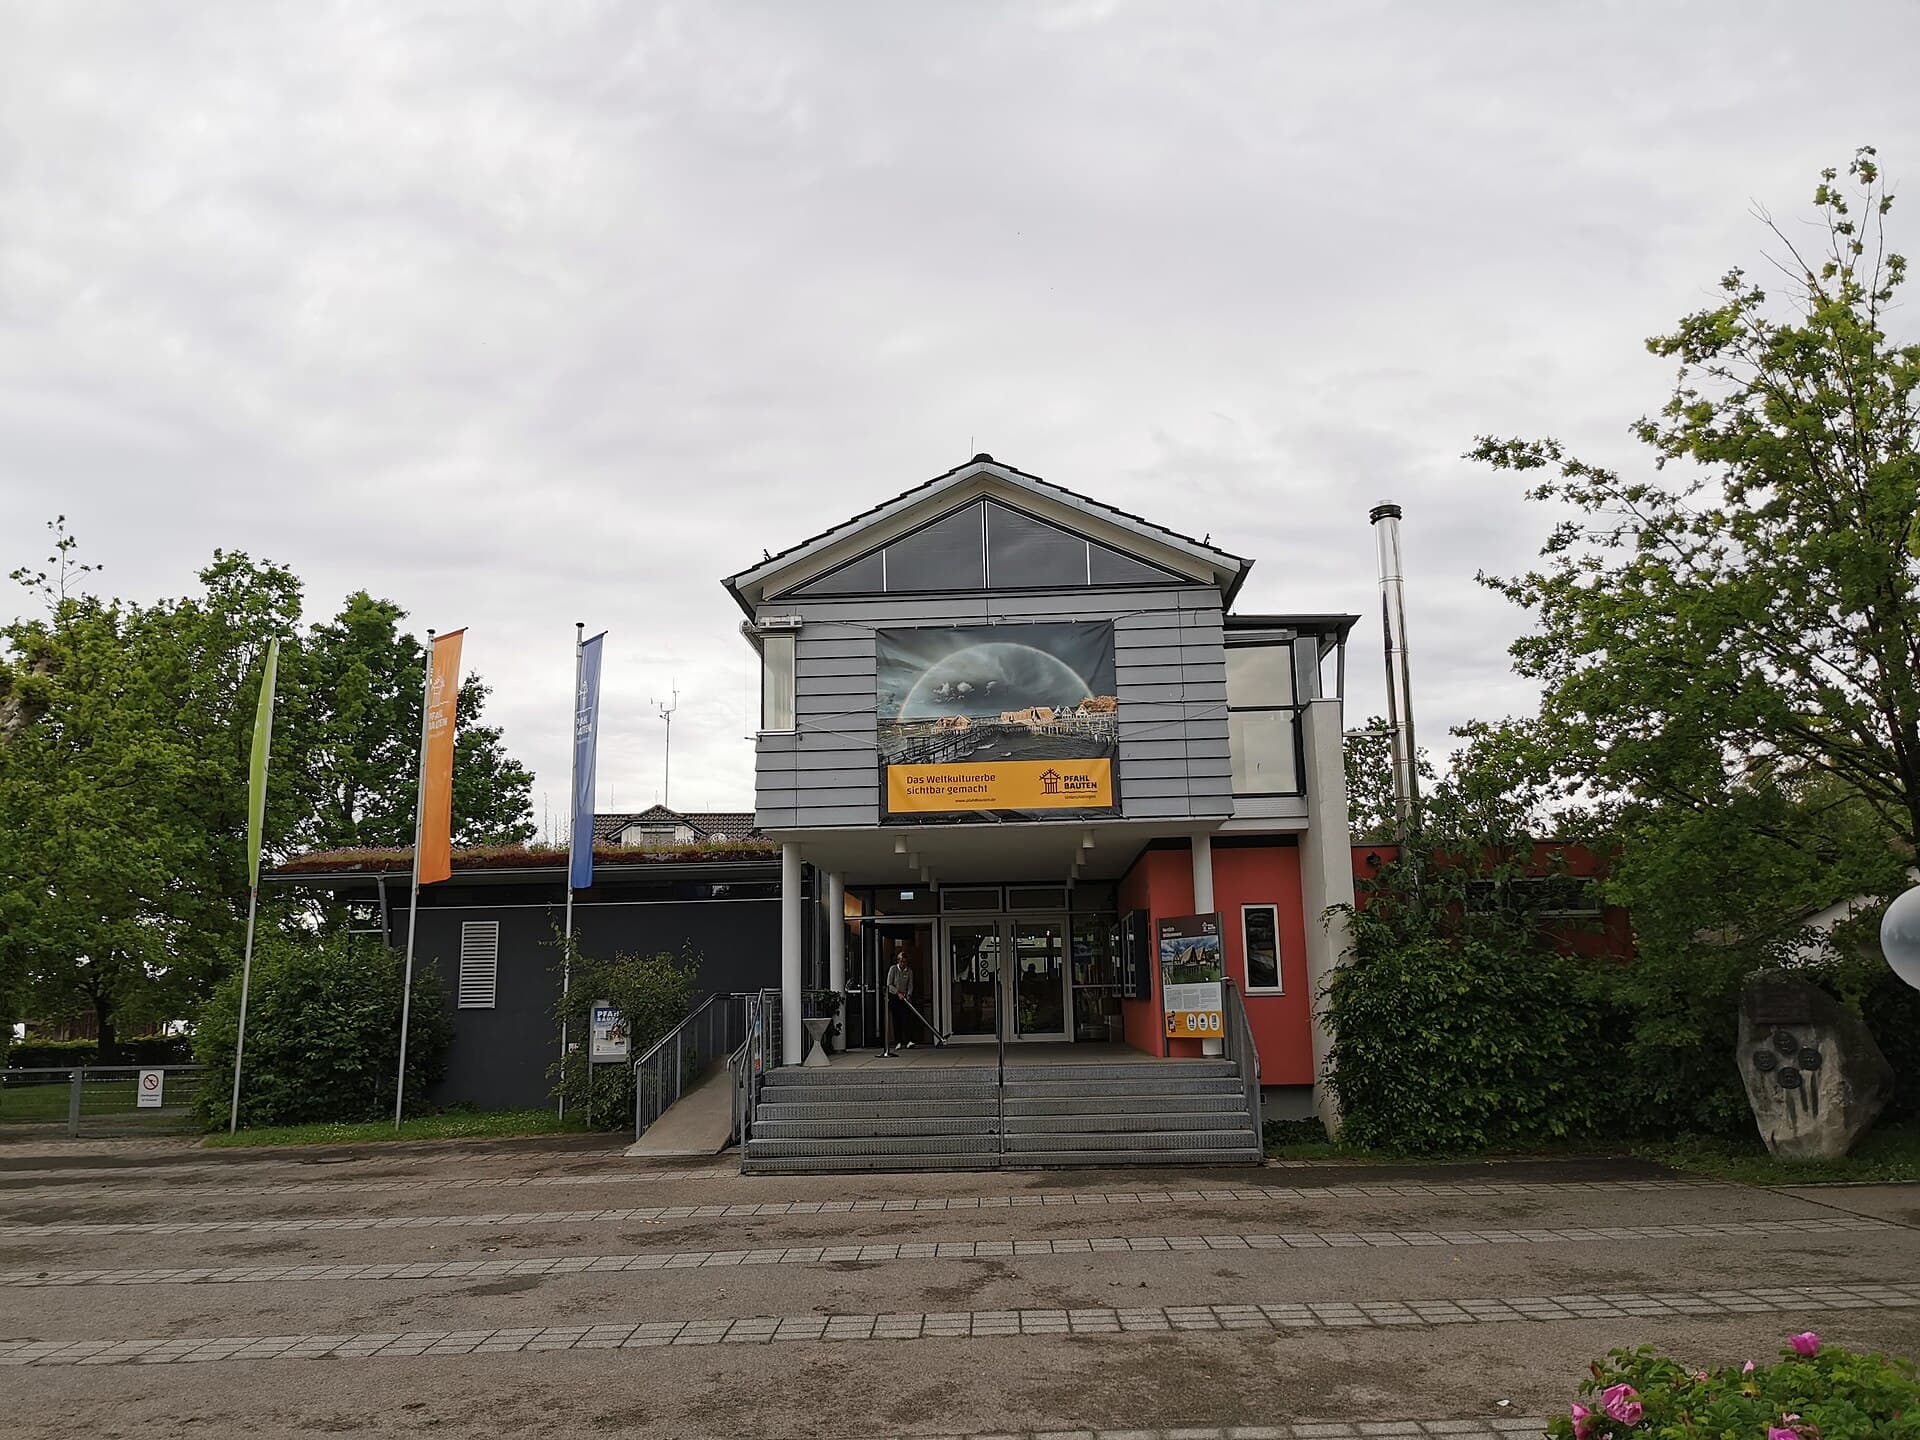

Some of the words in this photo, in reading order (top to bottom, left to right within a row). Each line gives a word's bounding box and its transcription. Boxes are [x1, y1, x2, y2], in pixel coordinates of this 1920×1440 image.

[906, 775, 924, 784] Das
[926, 774, 996, 784] Weltkulturerbe
[906, 785, 944, 795] sichtbar
[947, 784, 988, 795] gemacht
